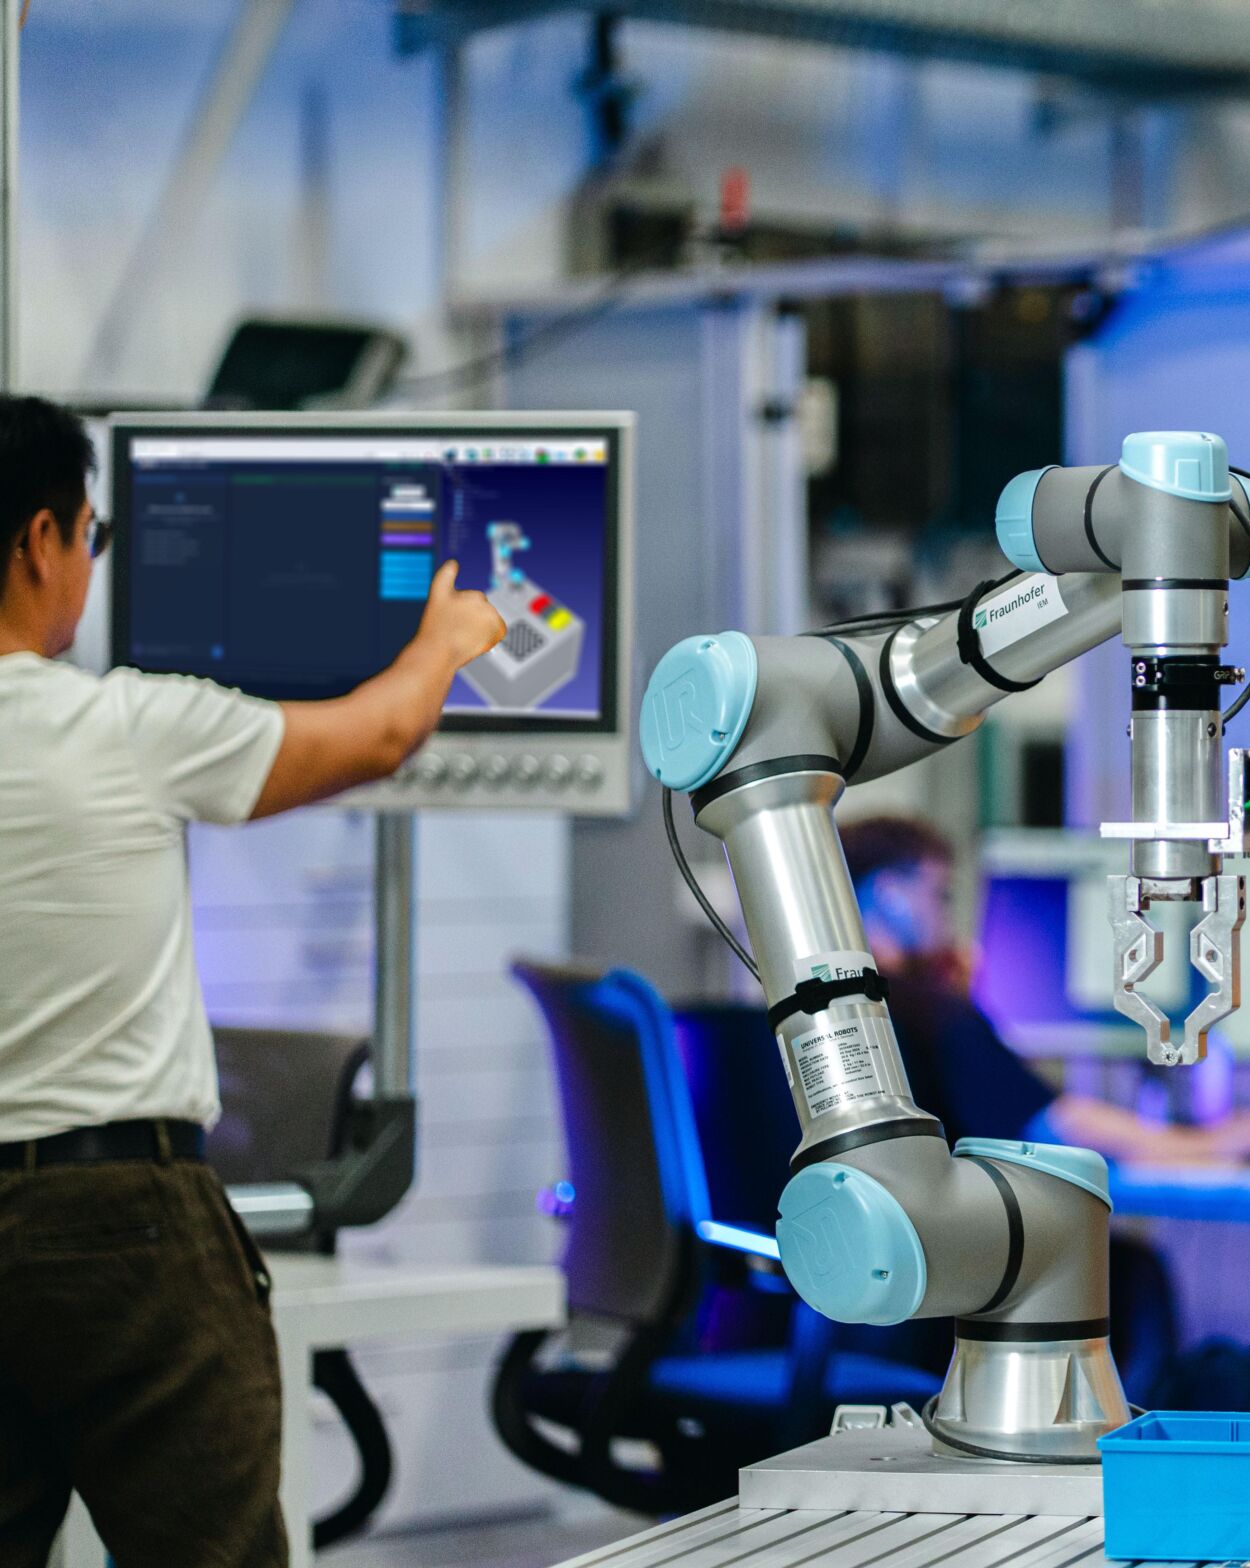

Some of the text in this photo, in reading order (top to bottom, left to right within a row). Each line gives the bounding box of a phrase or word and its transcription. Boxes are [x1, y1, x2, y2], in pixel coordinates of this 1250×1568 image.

[990, 584, 1045, 622] Fraunhofer
[1037, 599, 1048, 609] IEM
[834, 1026, 858, 1037] ROBOTS
